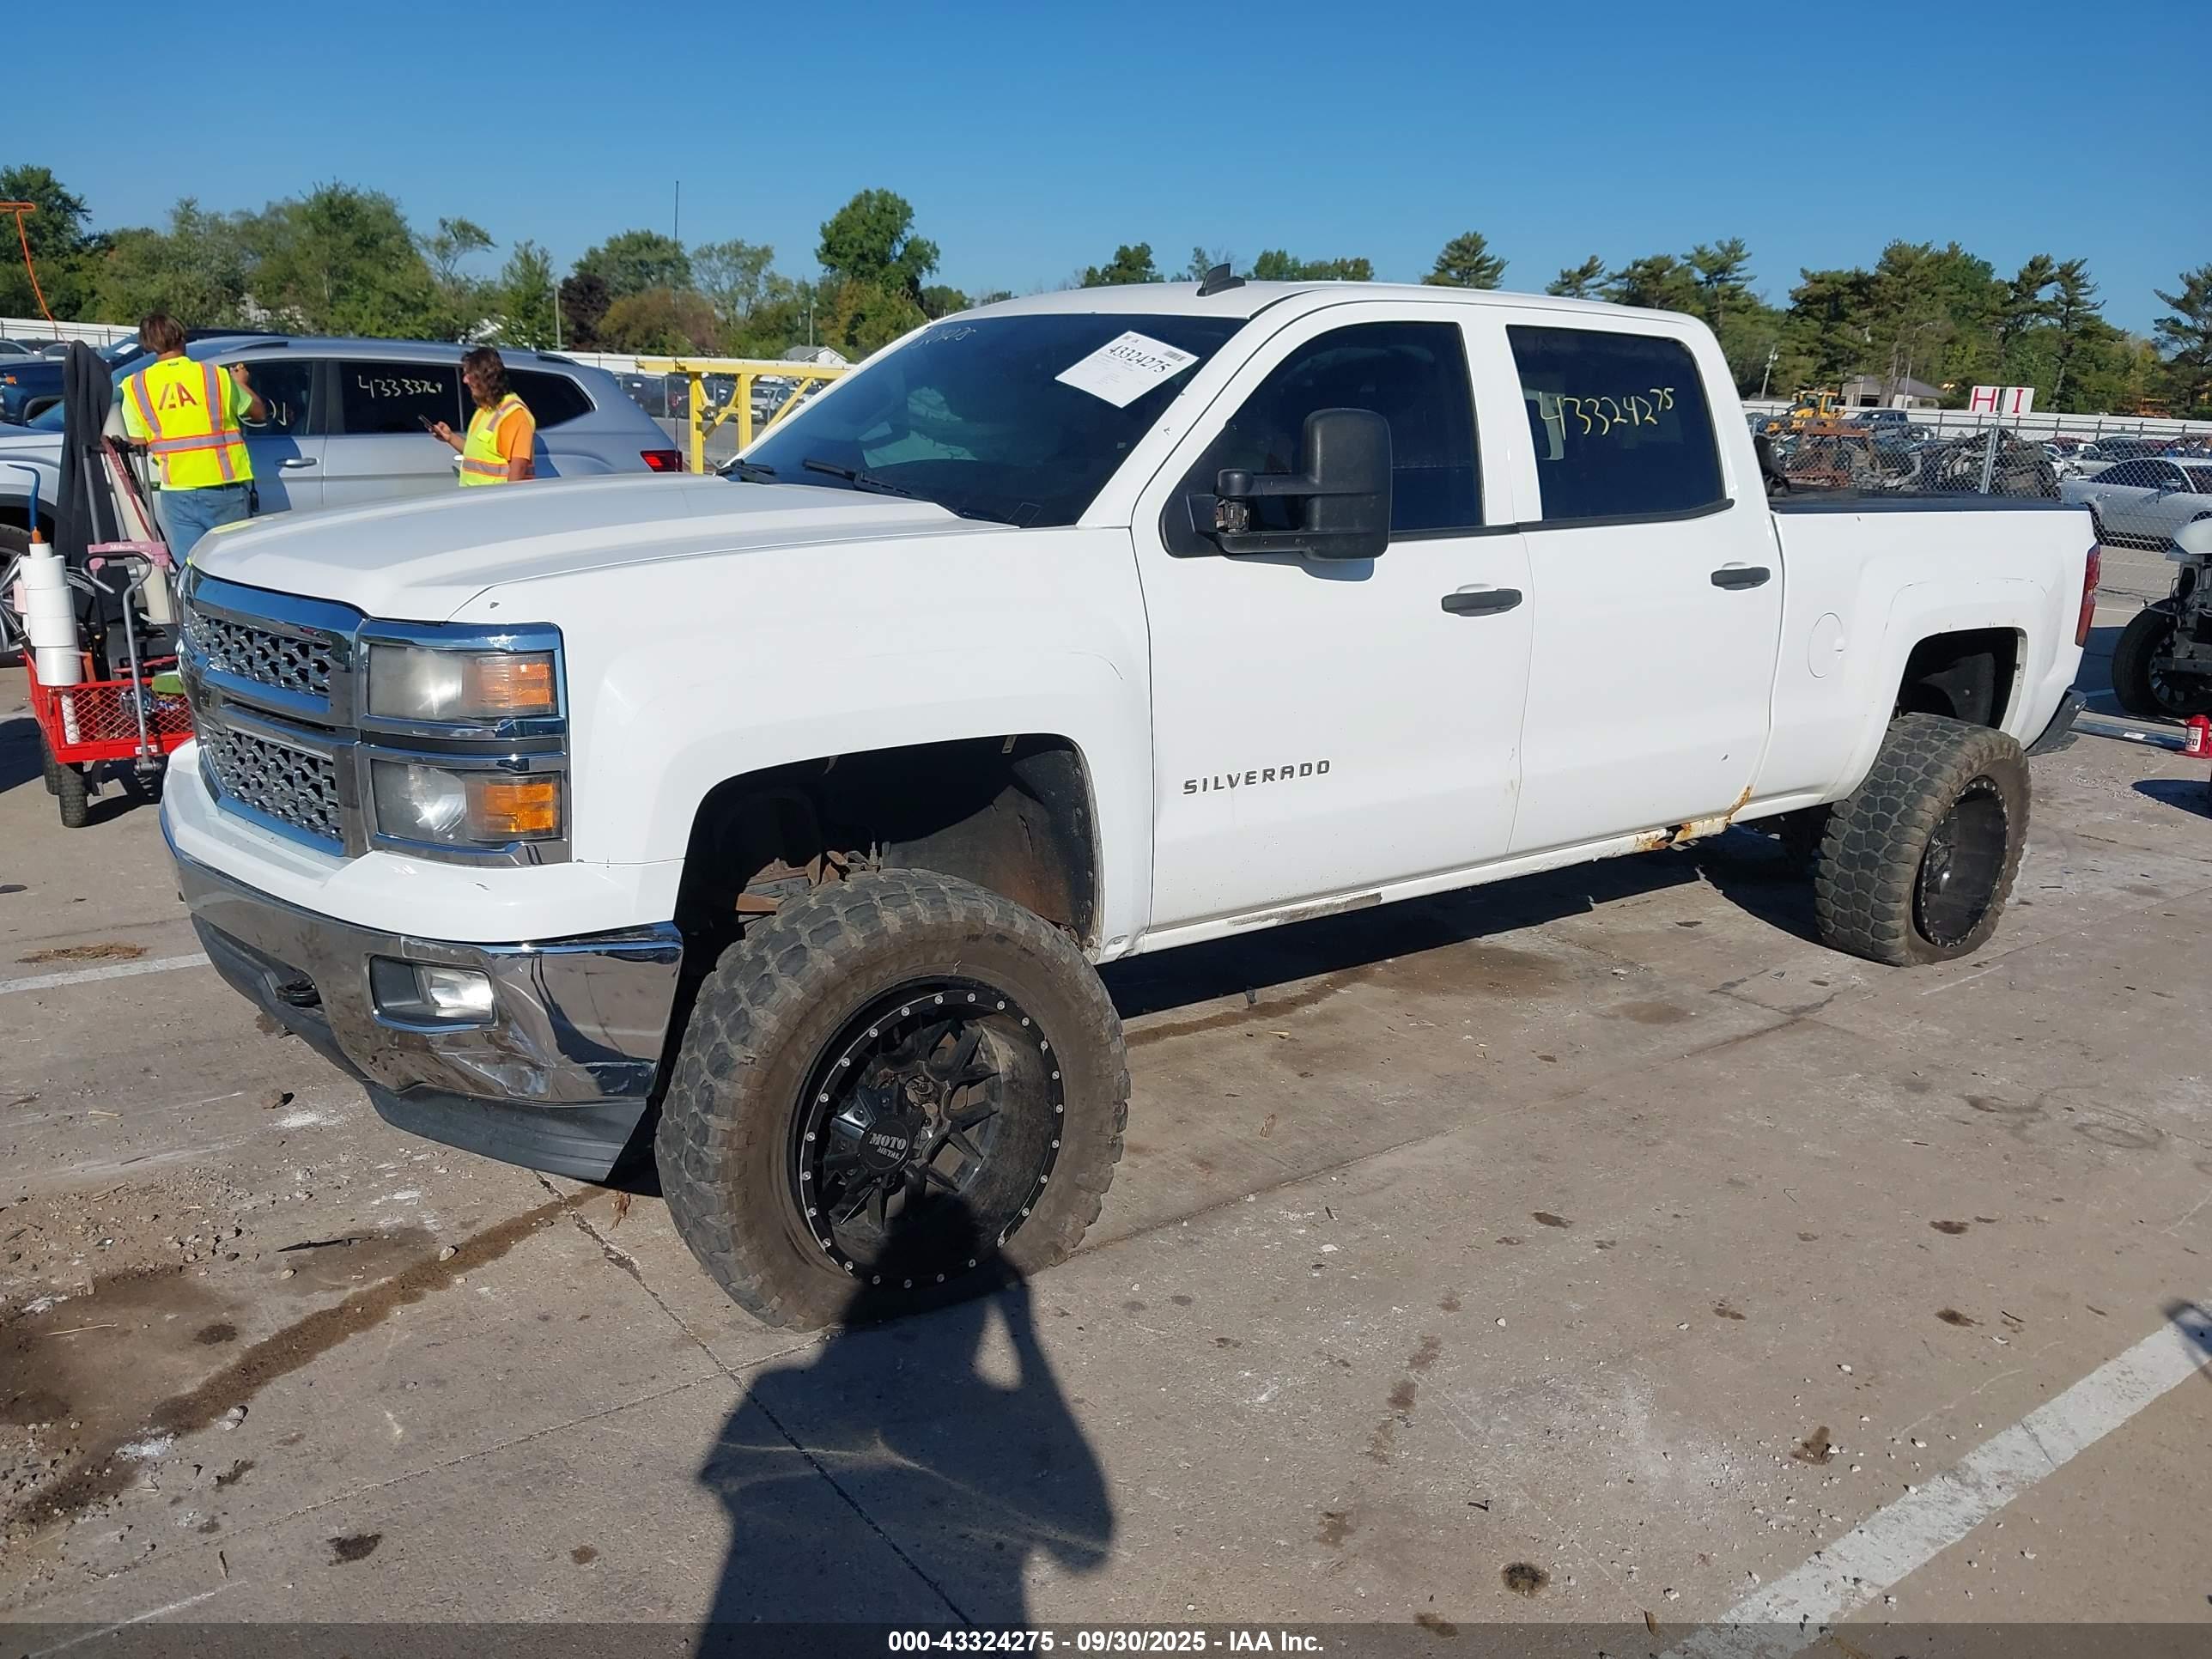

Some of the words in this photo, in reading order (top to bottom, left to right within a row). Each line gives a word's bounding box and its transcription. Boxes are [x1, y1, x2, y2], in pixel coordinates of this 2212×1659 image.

[1109, 344, 1172, 373] 43324275
[1182, 759, 1330, 794] SILVERADO
[869, 1133, 907, 1150] MOTO
[877, 1146, 900, 1160] METAL
